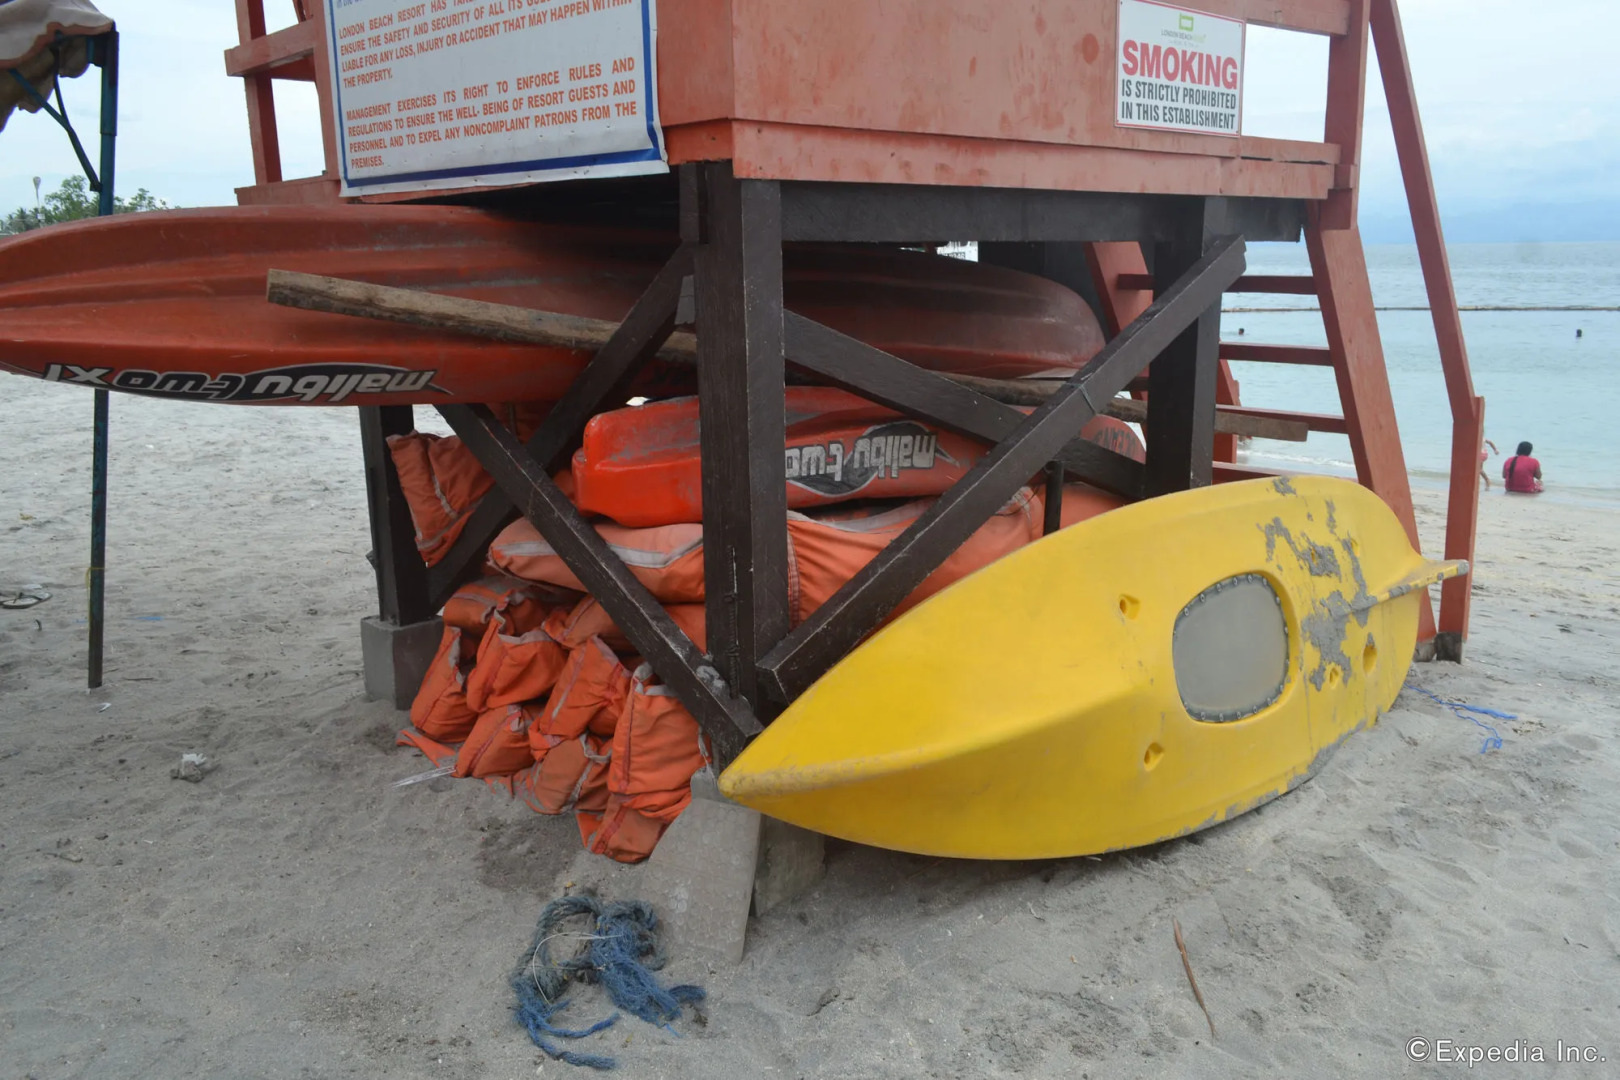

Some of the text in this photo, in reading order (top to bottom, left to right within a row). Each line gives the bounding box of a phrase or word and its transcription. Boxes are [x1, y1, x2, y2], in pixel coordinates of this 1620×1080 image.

[339, 22, 365, 39] LONDON
[369, 14, 393, 31] BEACH
[398, 4, 426, 23] RESORT
[430, 0, 447, 13] HAS
[340, 39, 366, 56] ENSURE
[367, 34, 382, 49] THE
[384, 27, 410, 45] SAFETY
[413, 22, 429, 37] AND
[431, 10, 470, 32] SECURITY
[473, 6, 485, 20] OF
[489, 2, 504, 17] ALL
[508, 0, 523, 12] ITS
[342, 57, 364, 73] LIABLE
[365, 53, 379, 67] FOR
[380, 49, 394, 64] ANY
[395, 44, 416, 60] LOSS,
[416, 36, 444, 55] INJURY
[446, 33, 458, 47] OR
[459, 22, 500, 44] ACCIDENT
[502, 15, 526, 33] THAT
[528, 10, 548, 27] MAY
[550, 0, 590, 22] HAPPEN
[592, 0, 632, 11] WITH
[343, 76, 356, 89] THE
[1122, 39, 1238, 90] SMOKING
[346, 56, 635, 121] MANAGEMENT EXERCISES ITS RIGHT TO ENFORCE RULES AND
[348, 79, 636, 138] REGULATIONS TO ENSURE THE WELL- BEING OF RESORT GUESTS AND
[1121, 78, 1236, 110] IS STRICTLY PROHIBITED
[349, 101, 637, 154] PERSONNEL AND TO EXPEL ANY NONCOMPLAINT PATRONS FROM THE
[1121, 101, 1235, 130] IN THIS ESTABLISHMENT
[351, 155, 385, 169] PREMISES.
[112, 369, 246, 400] two
[252, 370, 437, 402] malibu
[852, 434, 936, 479] malibu
